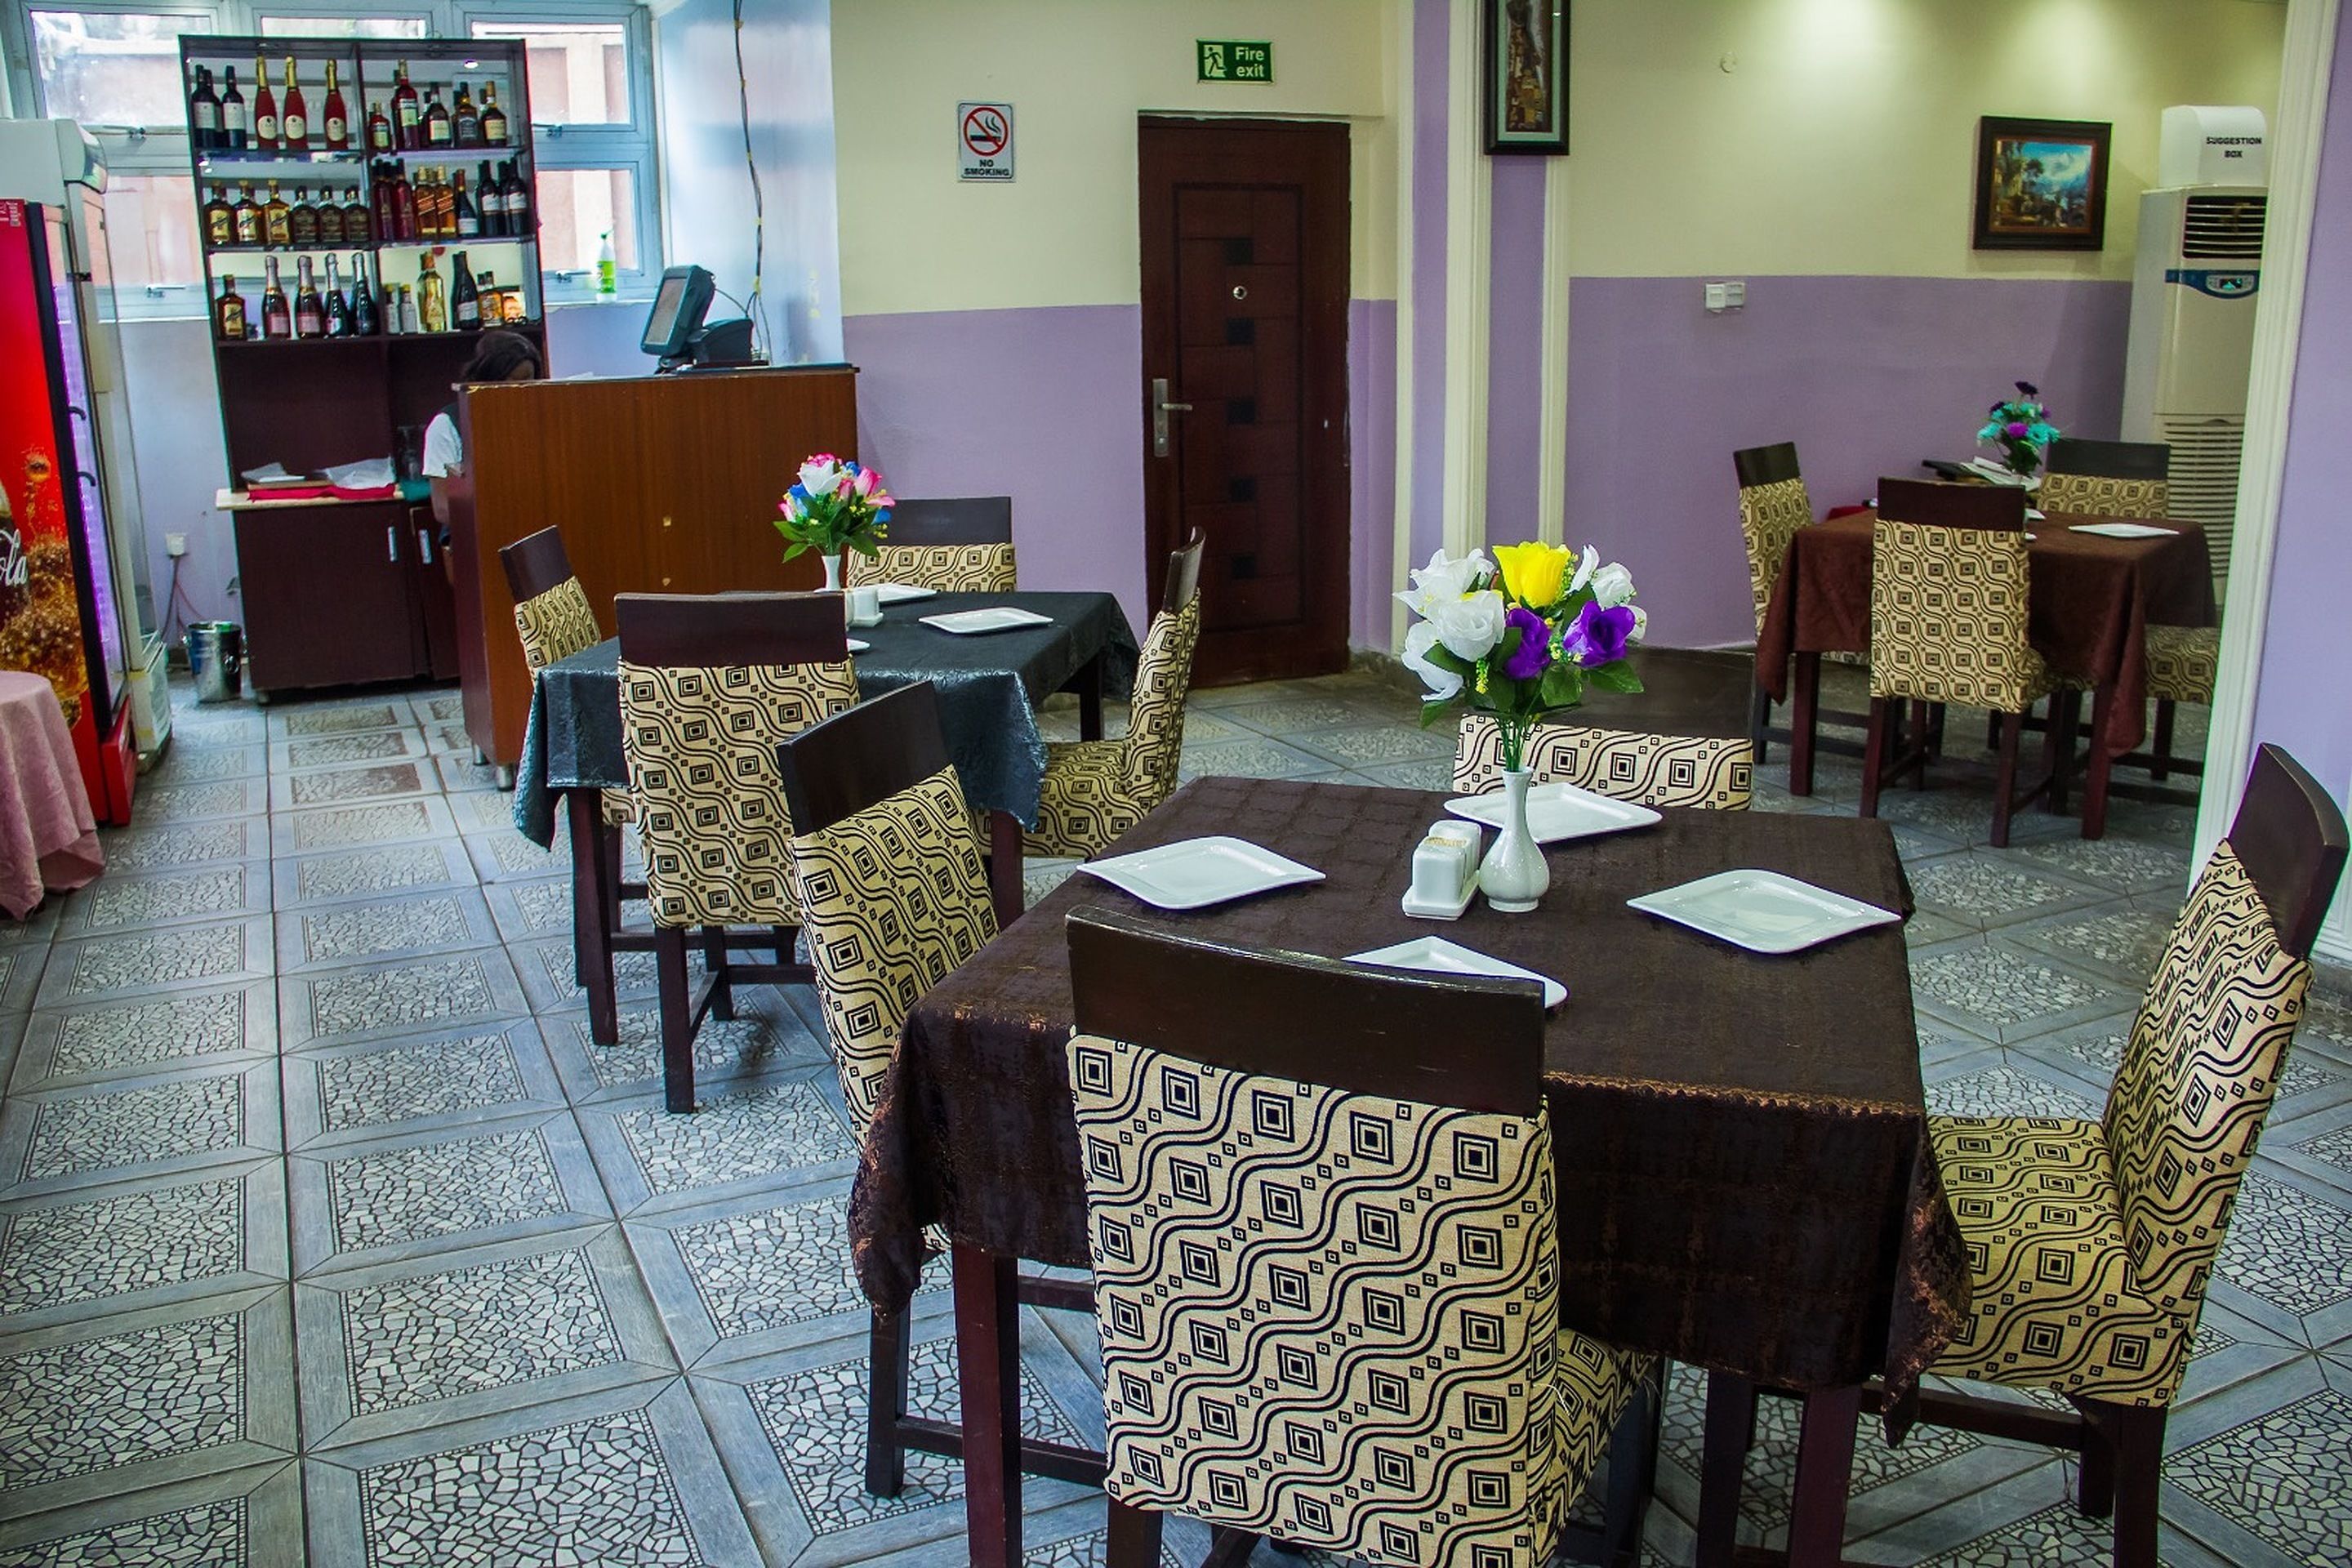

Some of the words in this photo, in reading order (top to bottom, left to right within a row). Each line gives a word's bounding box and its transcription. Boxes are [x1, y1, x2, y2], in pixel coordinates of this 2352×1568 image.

[1236, 47, 1264, 60] Fire
[1236, 64, 1264, 78] exit
[2207, 136, 2262, 145] SUGGESTION
[979, 159, 994, 167] NO
[964, 168, 1009, 176] SMOKING
